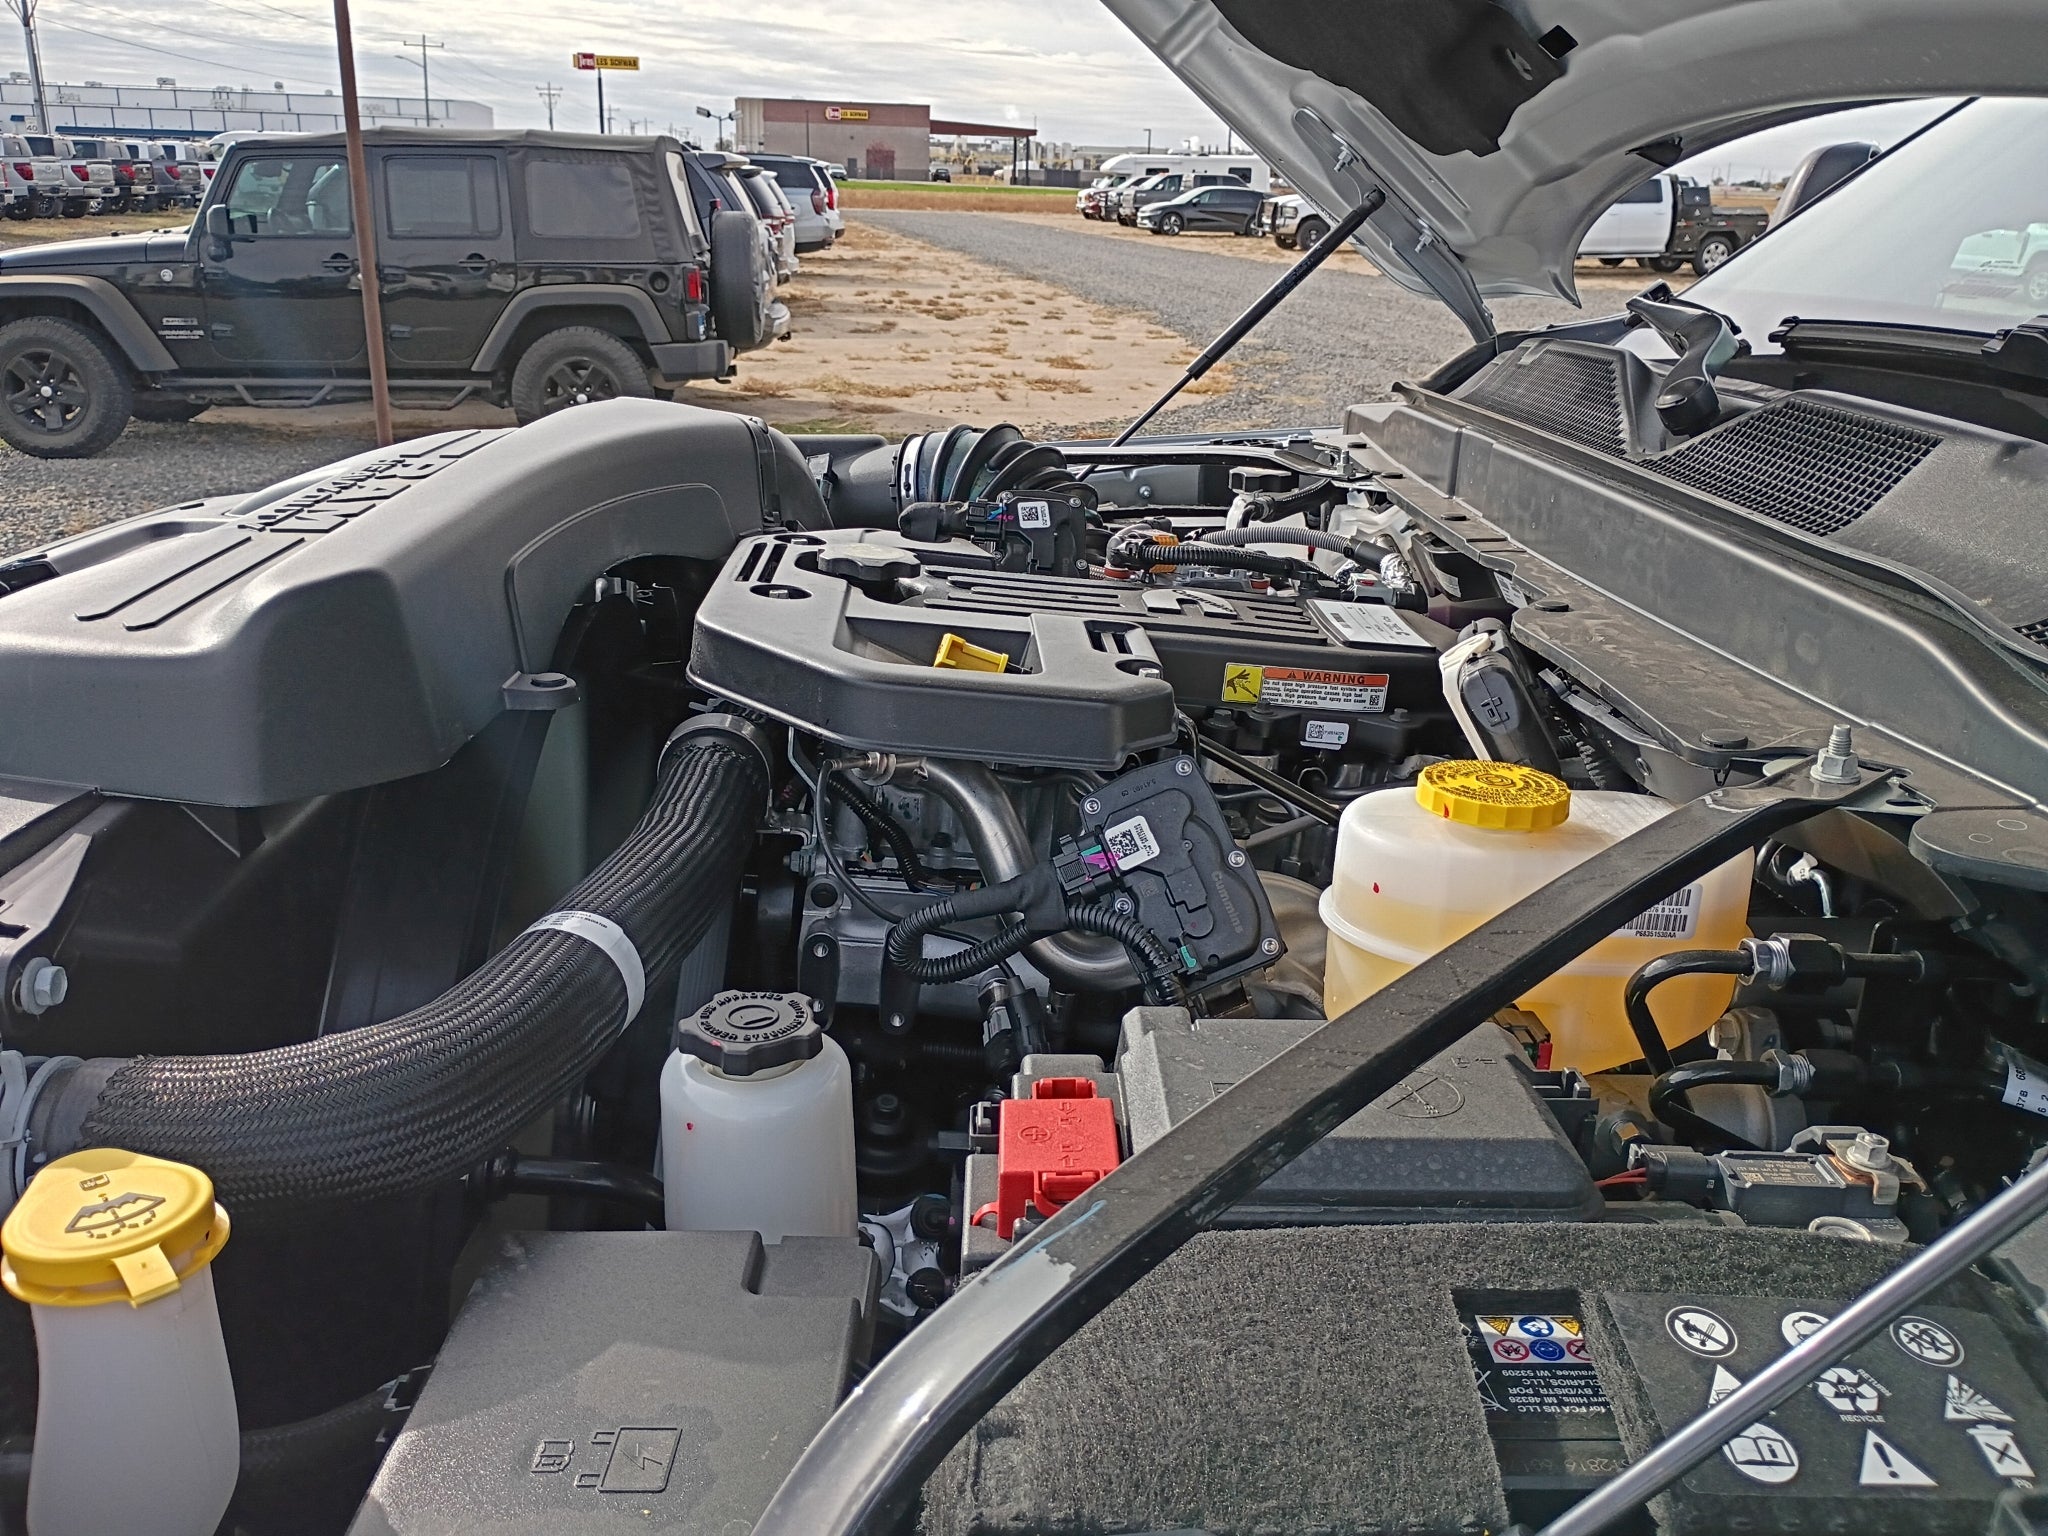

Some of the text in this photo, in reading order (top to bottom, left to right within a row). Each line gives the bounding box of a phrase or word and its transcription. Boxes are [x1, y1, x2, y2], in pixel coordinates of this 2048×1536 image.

[1303, 671, 1365, 684] WARNING
[1212, 870, 1243, 934] Cummins
[1857, 1368, 1892, 1397] RETURN
[1535, 1387, 1592, 1395] BY/DISTR.
[1839, 1384, 1857, 1394] Pb
[1508, 1396, 1541, 1404] 48326
[1517, 1405, 1540, 1413] LLC
[1543, 1405, 1560, 1413] US
[1561, 1405, 1587, 1413] FCA
[1588, 1405, 1606, 1413] for
[1839, 1414, 1886, 1424] RECYCLE
